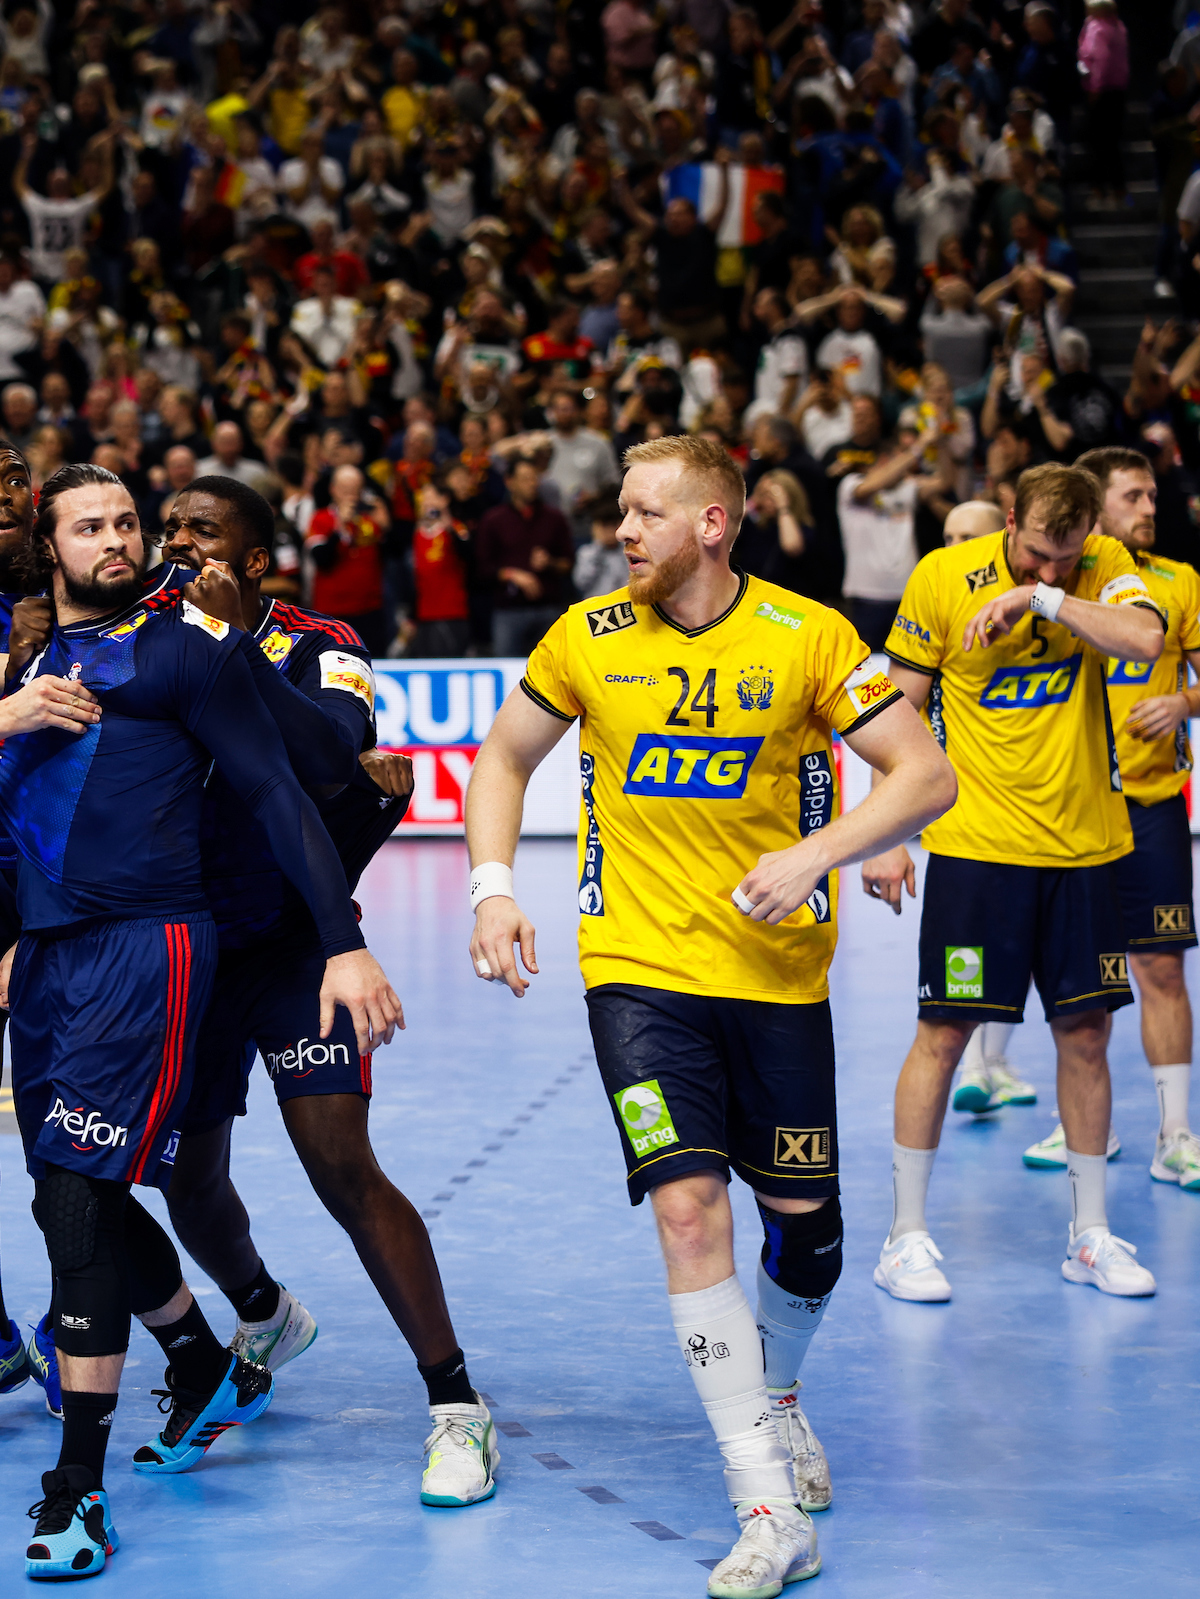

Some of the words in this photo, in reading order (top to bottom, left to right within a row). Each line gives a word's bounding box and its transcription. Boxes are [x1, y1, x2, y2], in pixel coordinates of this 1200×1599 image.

[588, 604, 635, 635] XL
[770, 611, 803, 631] bring
[1031, 616, 1049, 658] 5
[604, 674, 647, 685] CRAFT
[985, 666, 1072, 702] ATG
[665, 667, 719, 728] 24
[629, 747, 748, 787] ATG
[1157, 908, 1188, 931] XL
[1102, 957, 1128, 980] XL
[947, 982, 982, 999] bring
[631, 1126, 676, 1153] bring
[778, 1133, 828, 1163] XL
